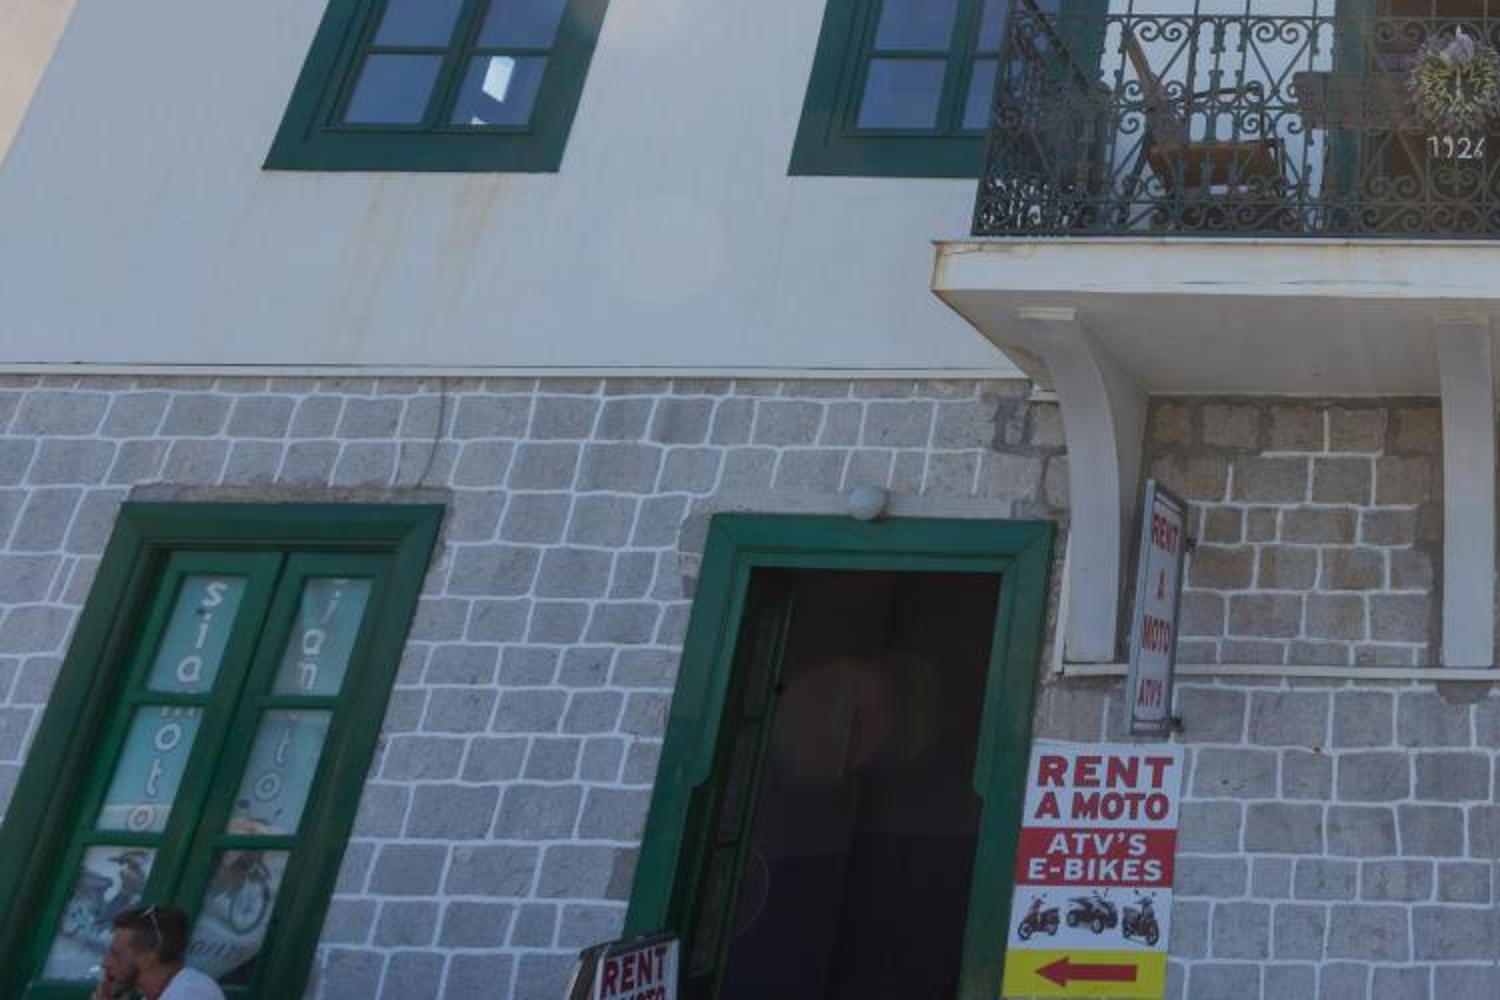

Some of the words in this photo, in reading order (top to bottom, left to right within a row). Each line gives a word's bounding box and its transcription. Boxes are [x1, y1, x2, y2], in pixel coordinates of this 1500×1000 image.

[1151, 514, 1181, 553] RENT
[1037, 755, 1175, 788] RENT
[1034, 792, 1060, 819] A
[1071, 792, 1169, 820] MOTO
[1028, 857, 1162, 881] E-BIKES
[600, 946, 667, 999] RENT
